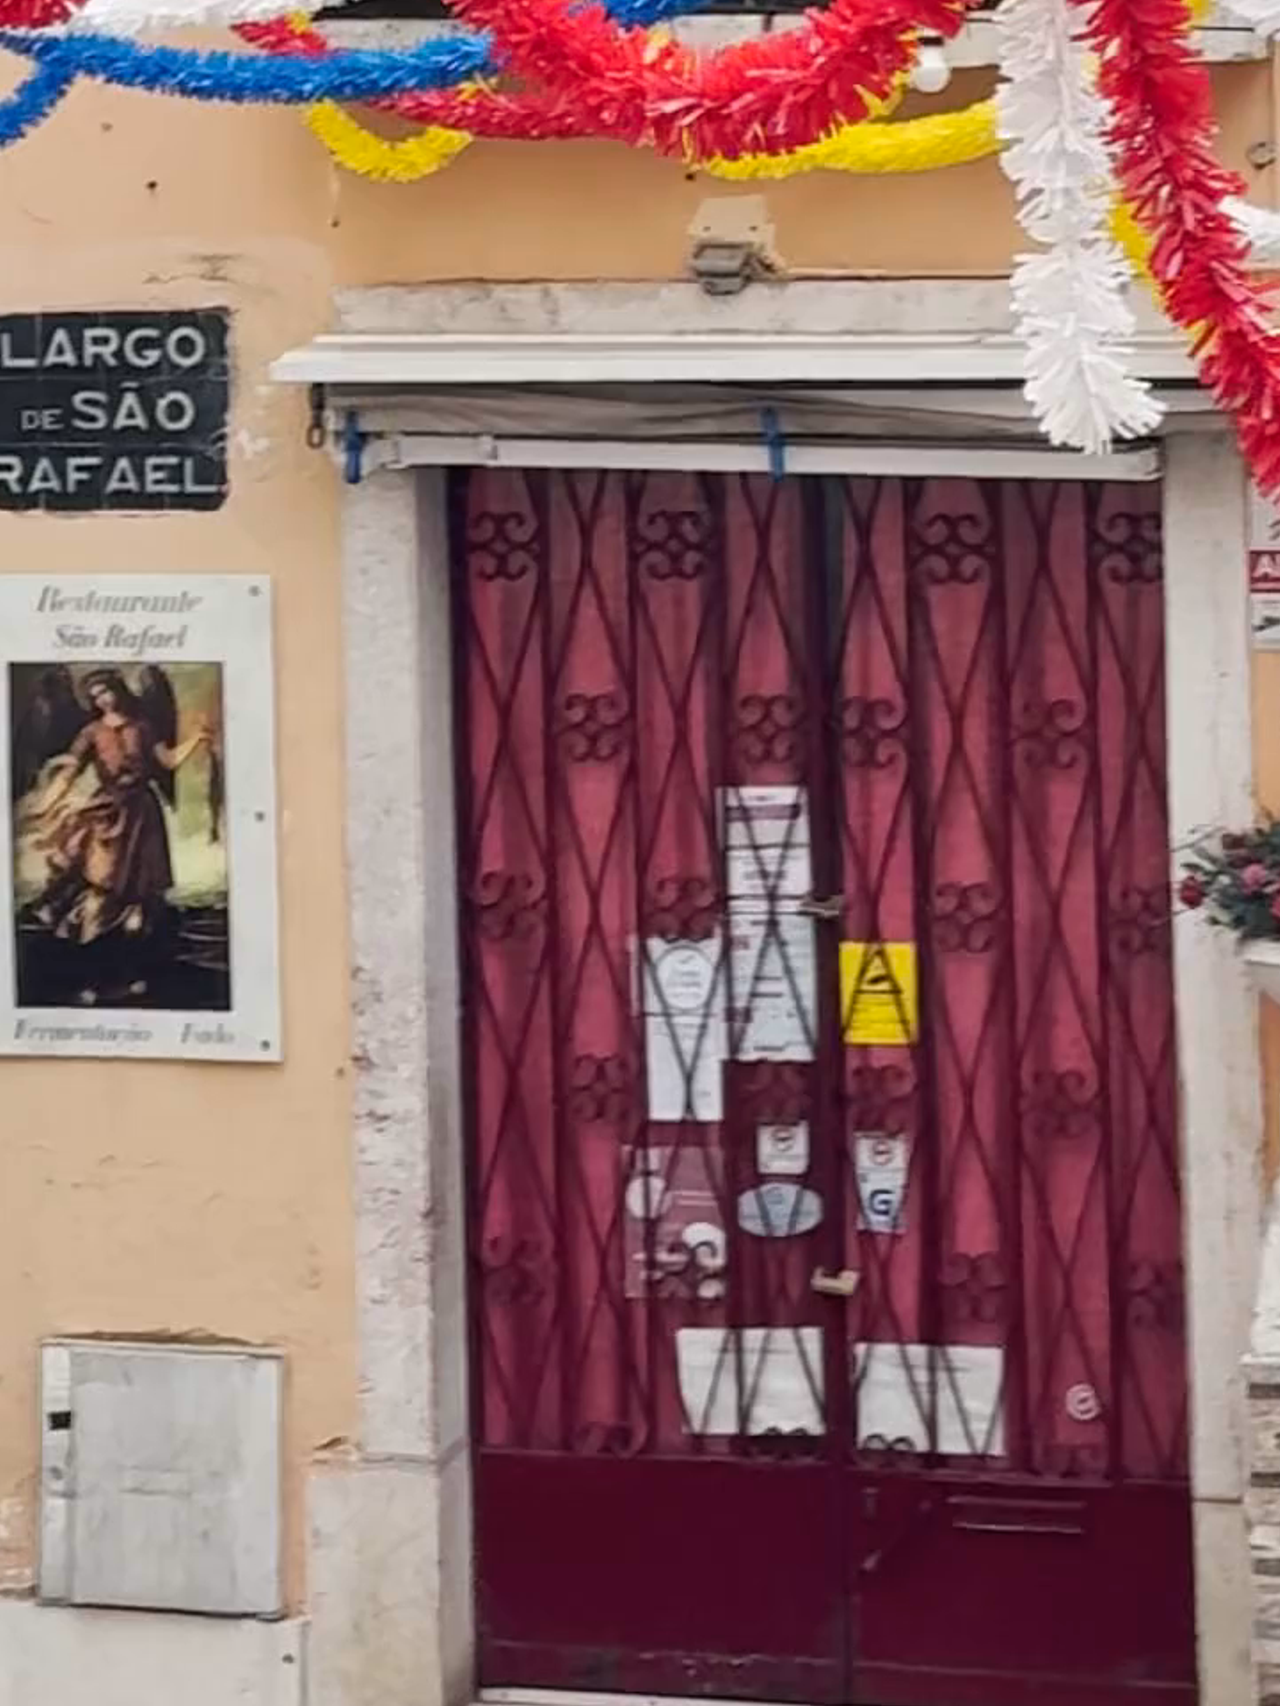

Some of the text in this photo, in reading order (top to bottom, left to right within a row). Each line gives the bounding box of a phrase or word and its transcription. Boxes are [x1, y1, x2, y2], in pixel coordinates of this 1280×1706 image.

[0, 326, 206, 369] LARGO
[20, 381, 196, 431] DE SÃO
[36, 585, 204, 613] Restaurante
[53, 623, 190, 657] São Rafael
